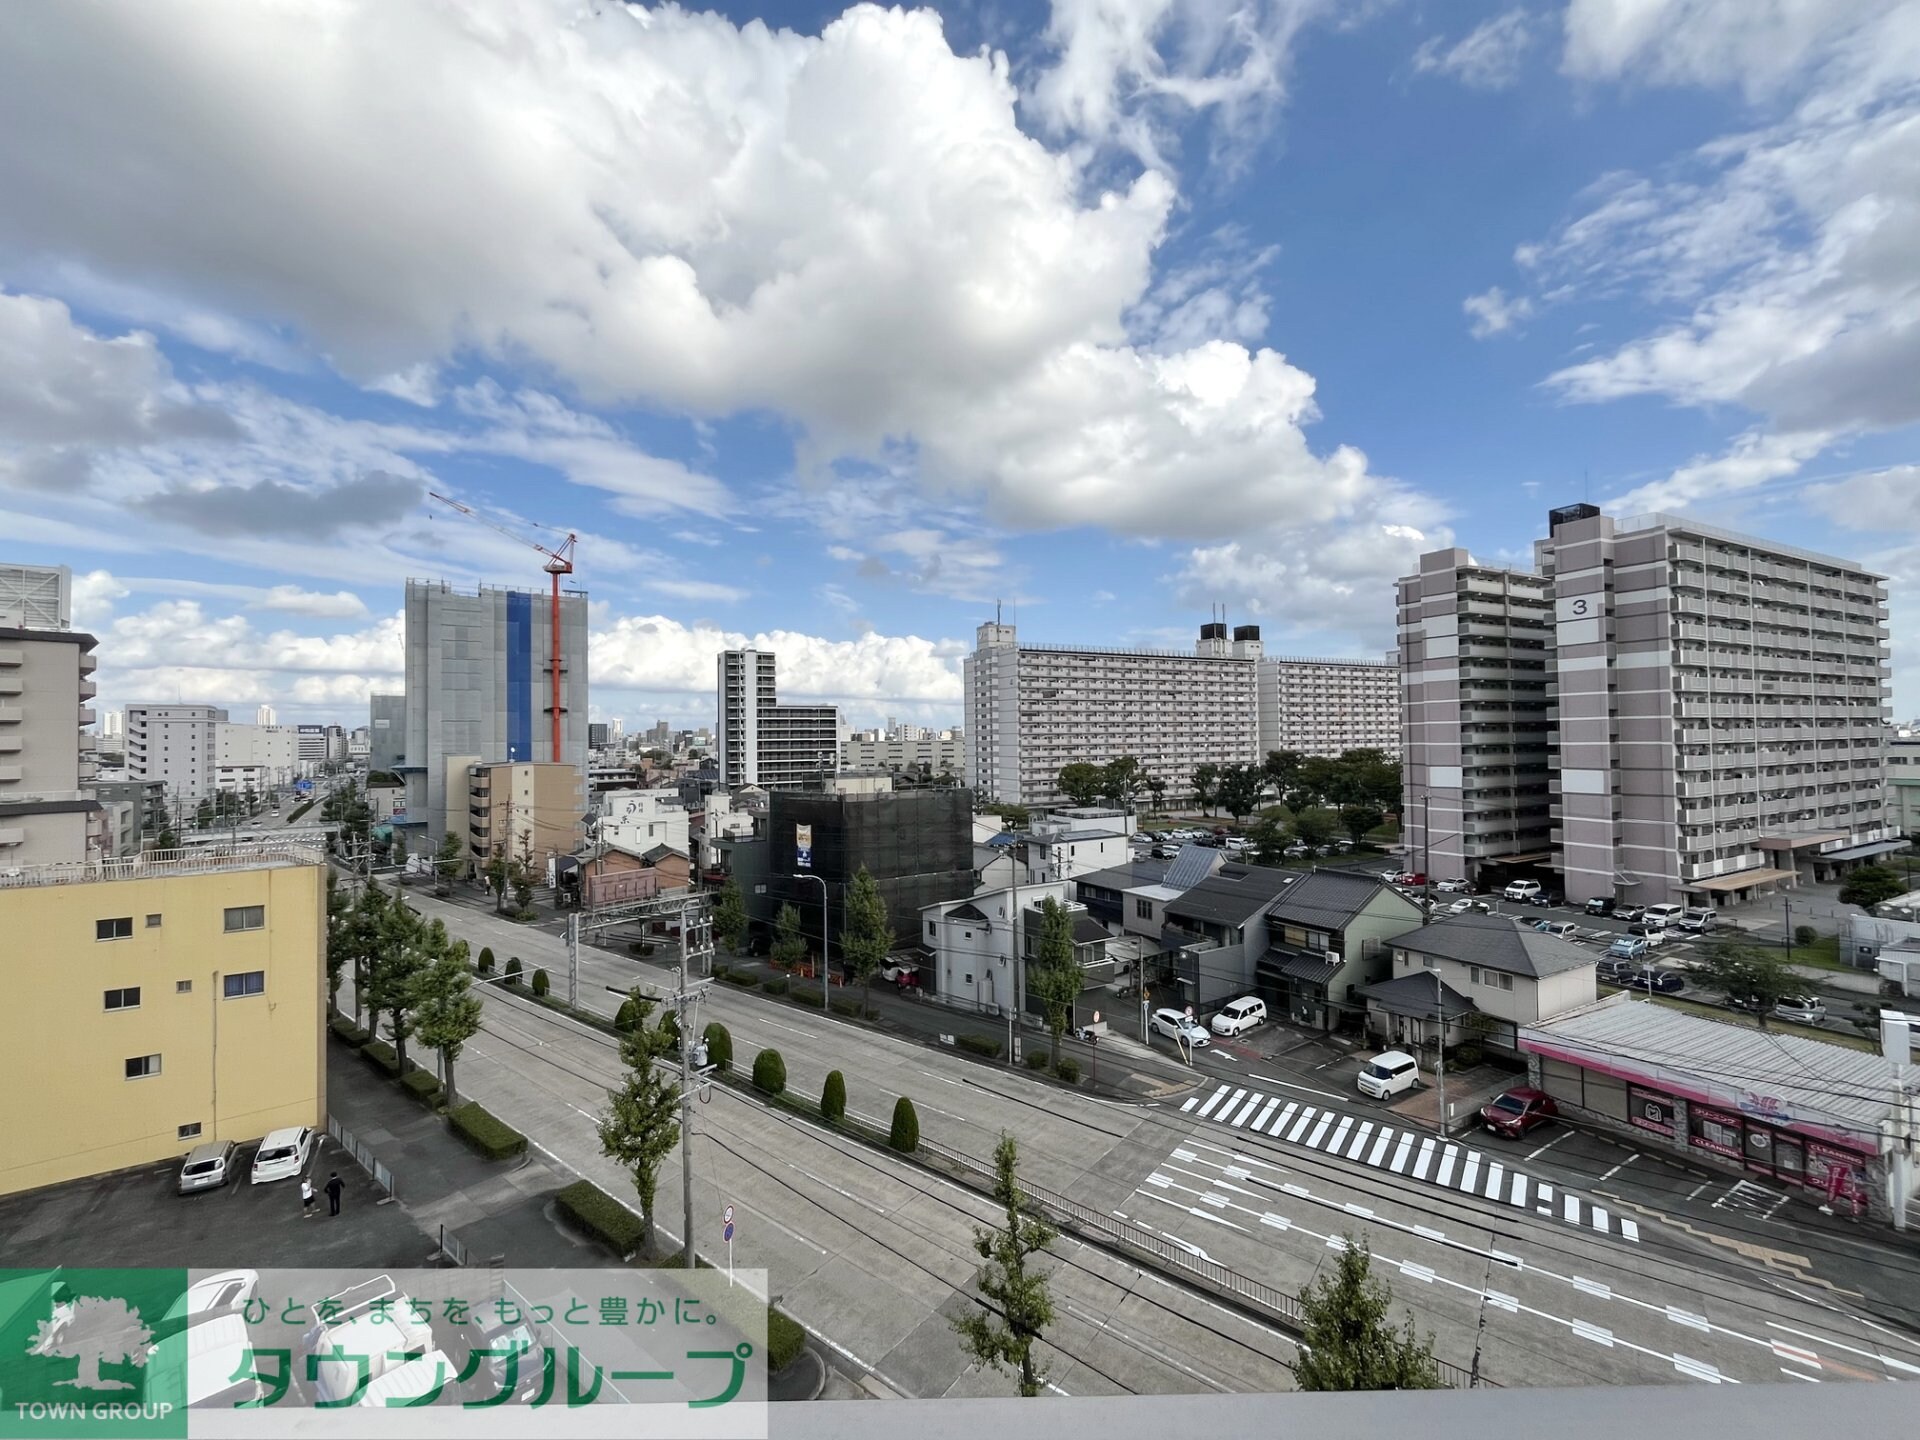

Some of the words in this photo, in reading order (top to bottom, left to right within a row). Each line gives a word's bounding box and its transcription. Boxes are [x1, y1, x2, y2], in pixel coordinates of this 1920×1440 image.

[1572, 599, 1588, 615] 3
[1695, 1139, 1739, 1157] CLEANING
[1810, 1144, 1863, 1164] CLEANING
